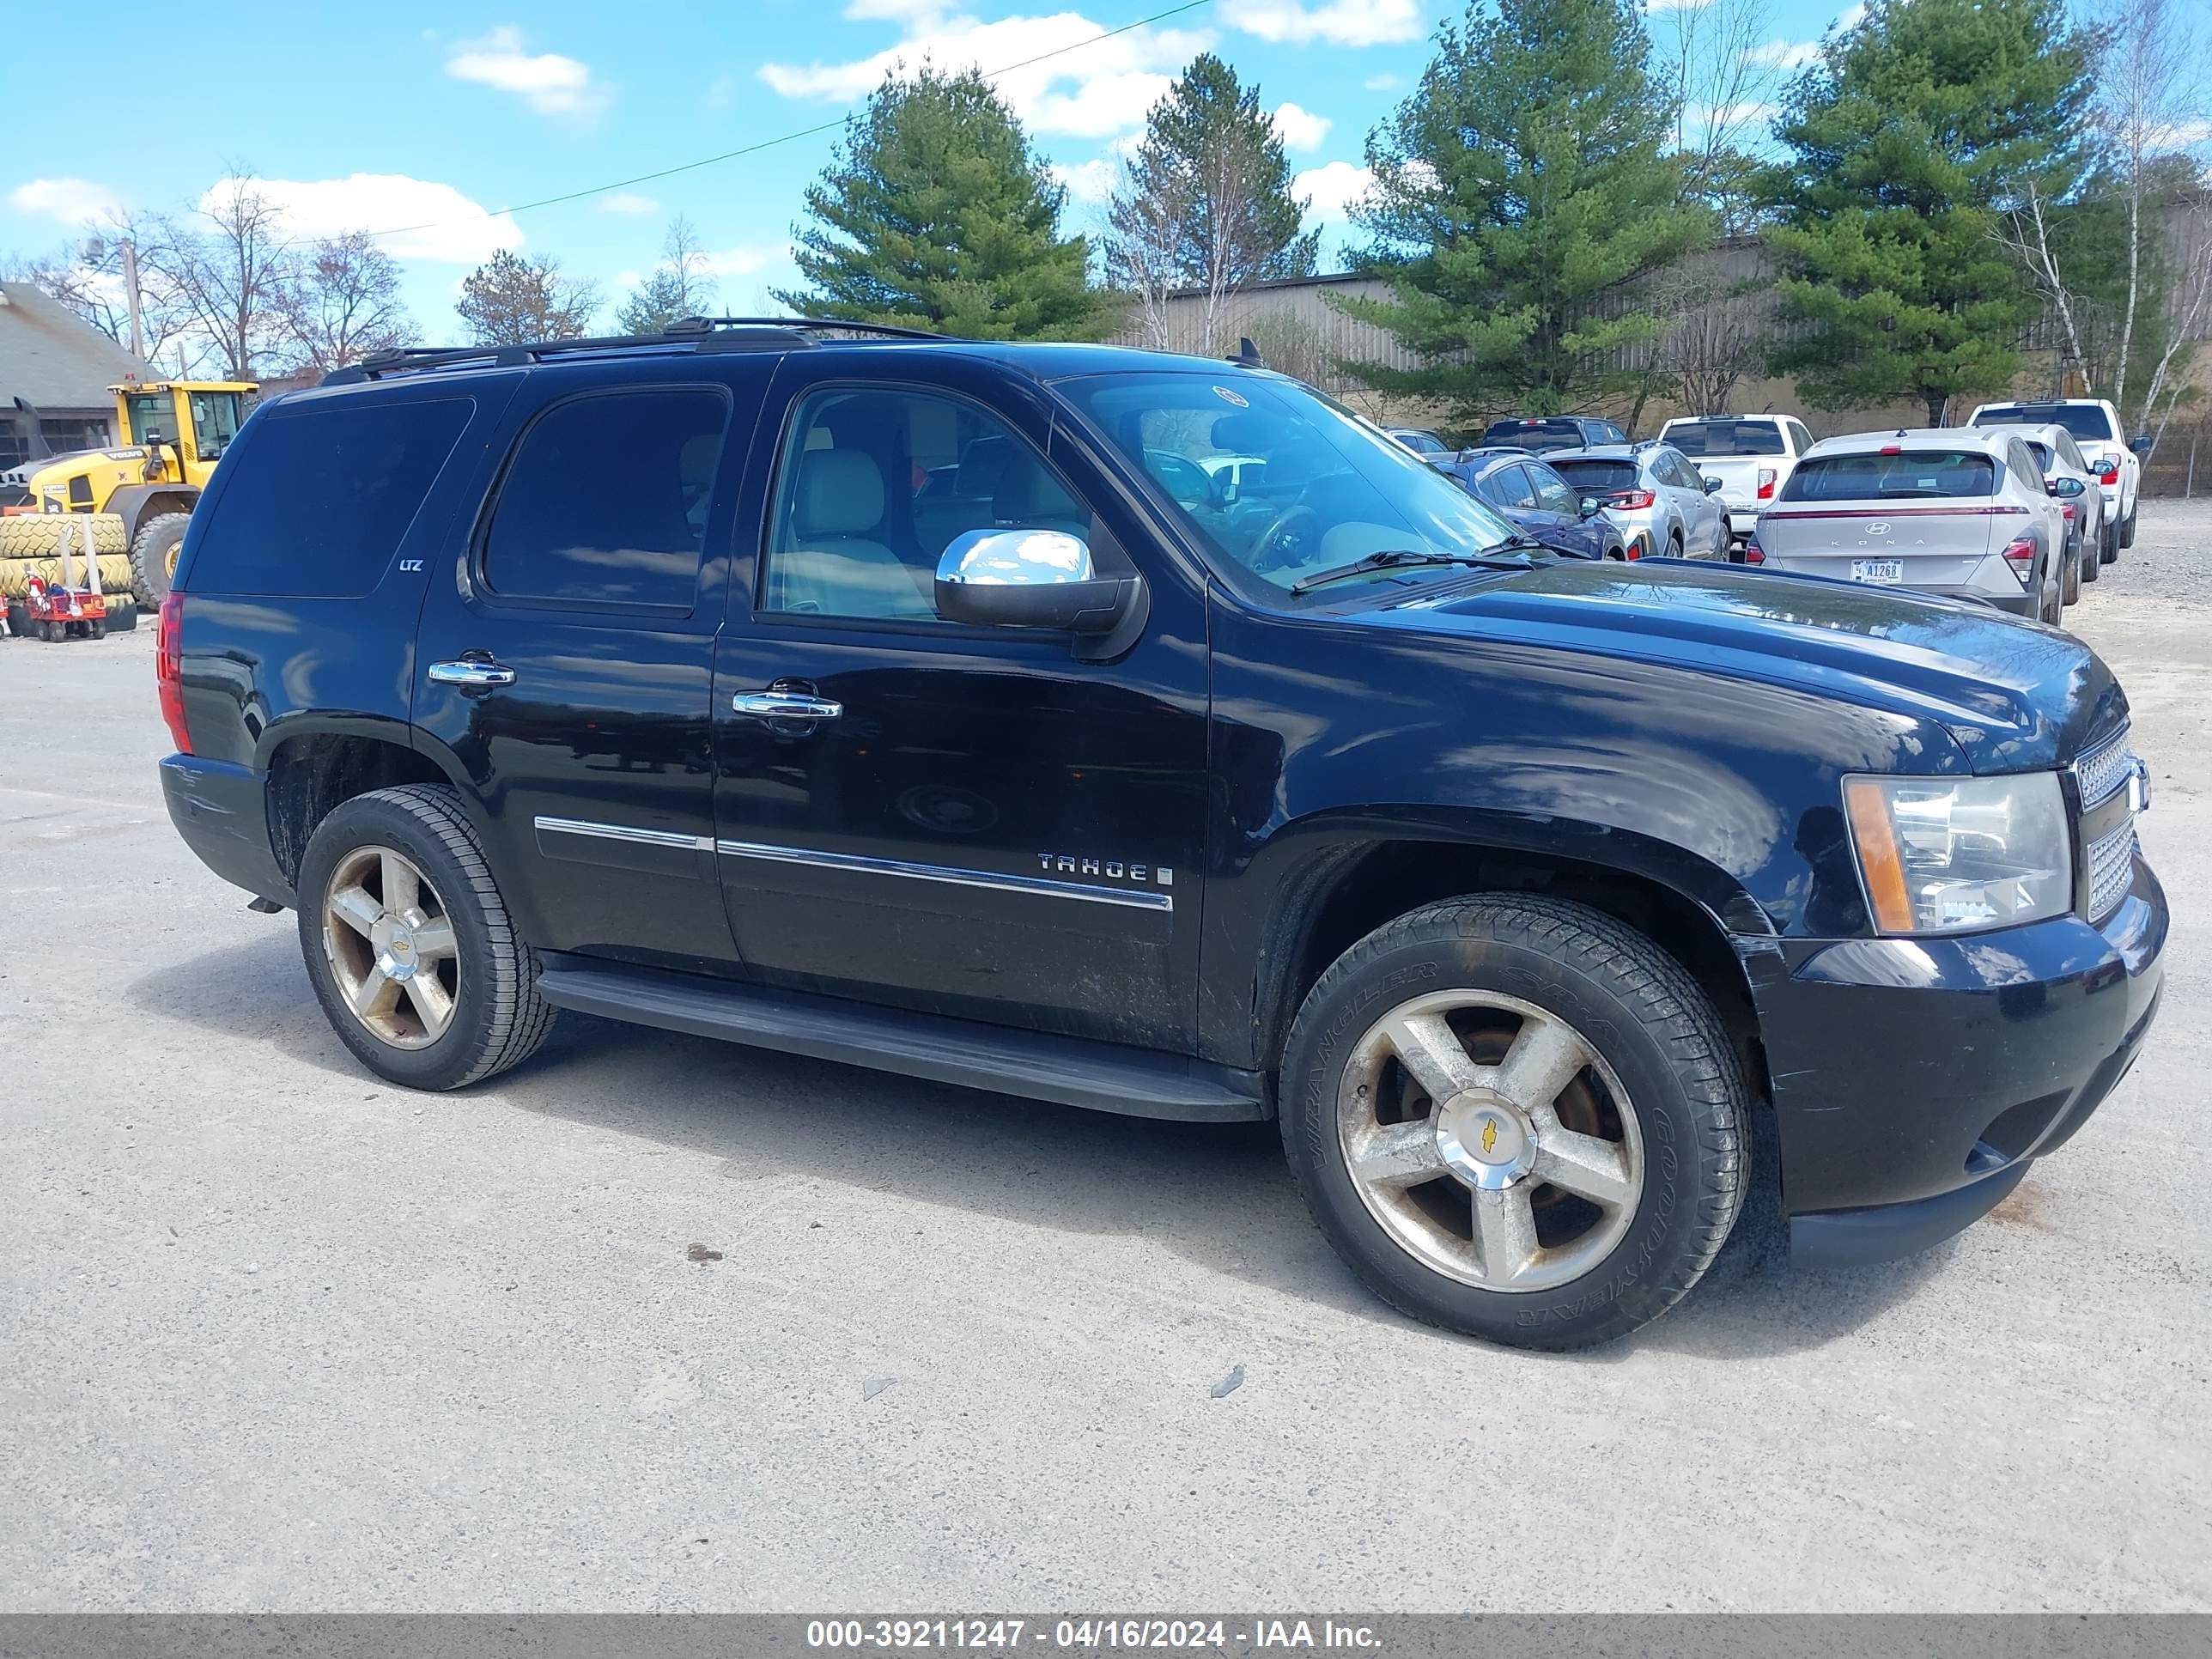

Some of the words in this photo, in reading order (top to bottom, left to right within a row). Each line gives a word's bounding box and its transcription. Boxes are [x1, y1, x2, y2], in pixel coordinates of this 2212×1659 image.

[108, 450, 144, 459] VOLVO
[1831, 538, 1925, 547] KONA
[399, 559, 424, 572] LTZ
[1866, 564, 1897, 577] A1268
[1037, 853, 1147, 881] TAHOE
[1305, 961, 1439, 1170] WRANGLER
[1515, 1106, 1679, 1327] GOODYEAR
